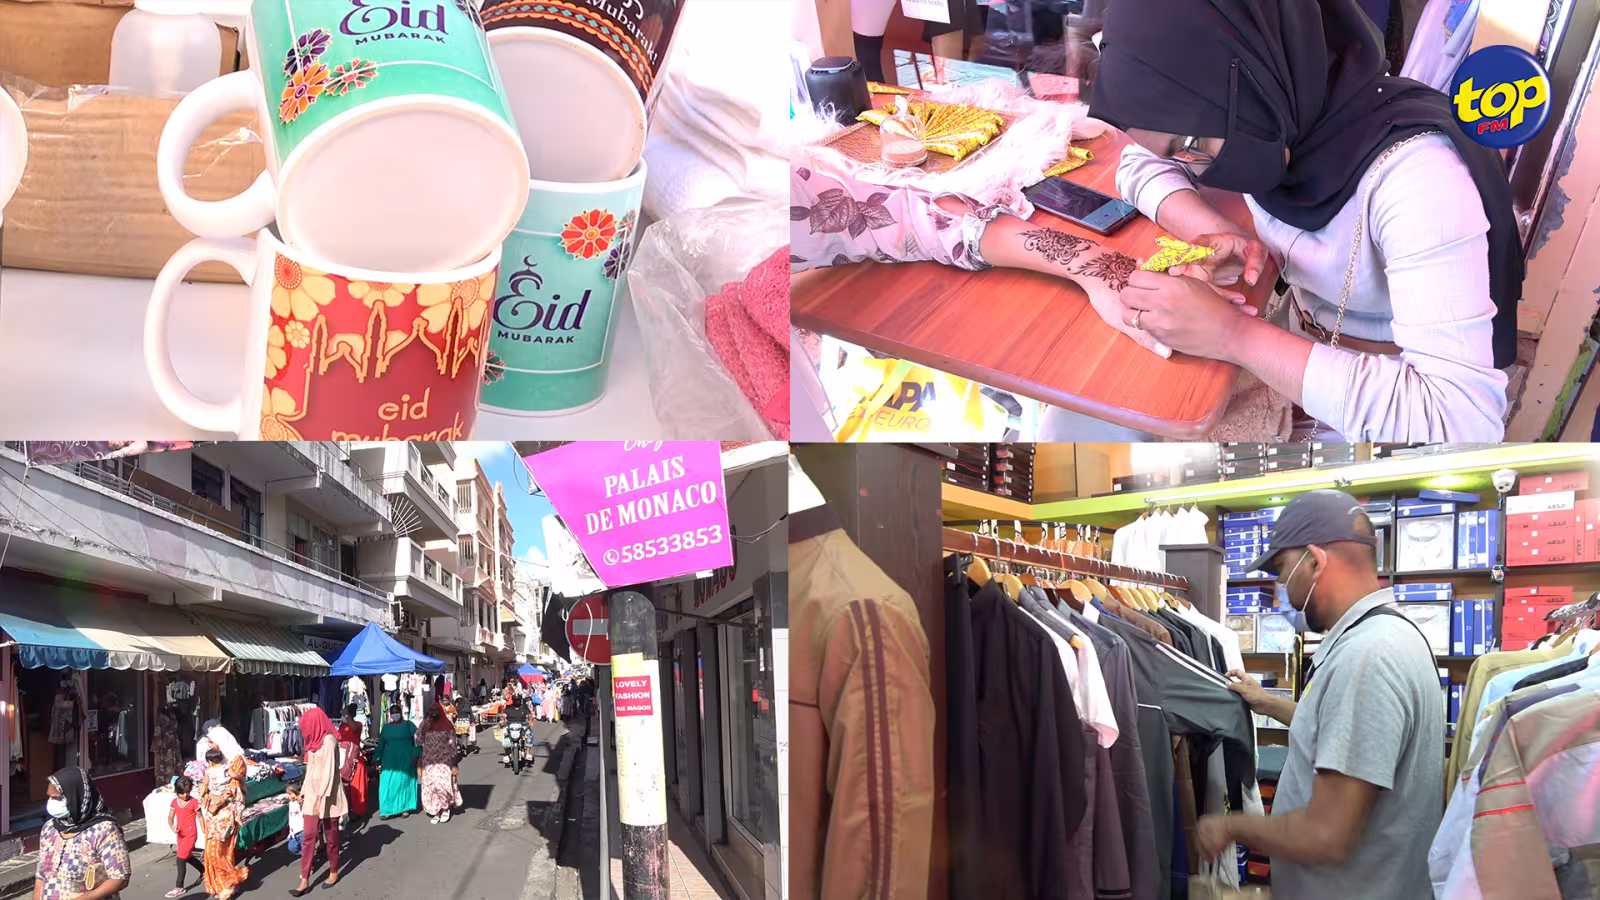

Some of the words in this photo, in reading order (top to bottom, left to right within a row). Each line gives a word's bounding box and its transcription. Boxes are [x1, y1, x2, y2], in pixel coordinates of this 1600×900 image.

[339, 0, 449, 36] Eid
[355, 32, 446, 46] MUBARAK
[492, 268, 592, 331] Eid
[497, 330, 575, 344] MUBARAK
[377, 387, 431, 421] eid
[604, 455, 686, 498] PALAIS
[584, 508, 613, 535] DE
[616, 480, 717, 527] MONACO
[621, 524, 723, 563] 58533853
[615, 680, 647, 688] LOVELY
[615, 692, 650, 700] FASHION
